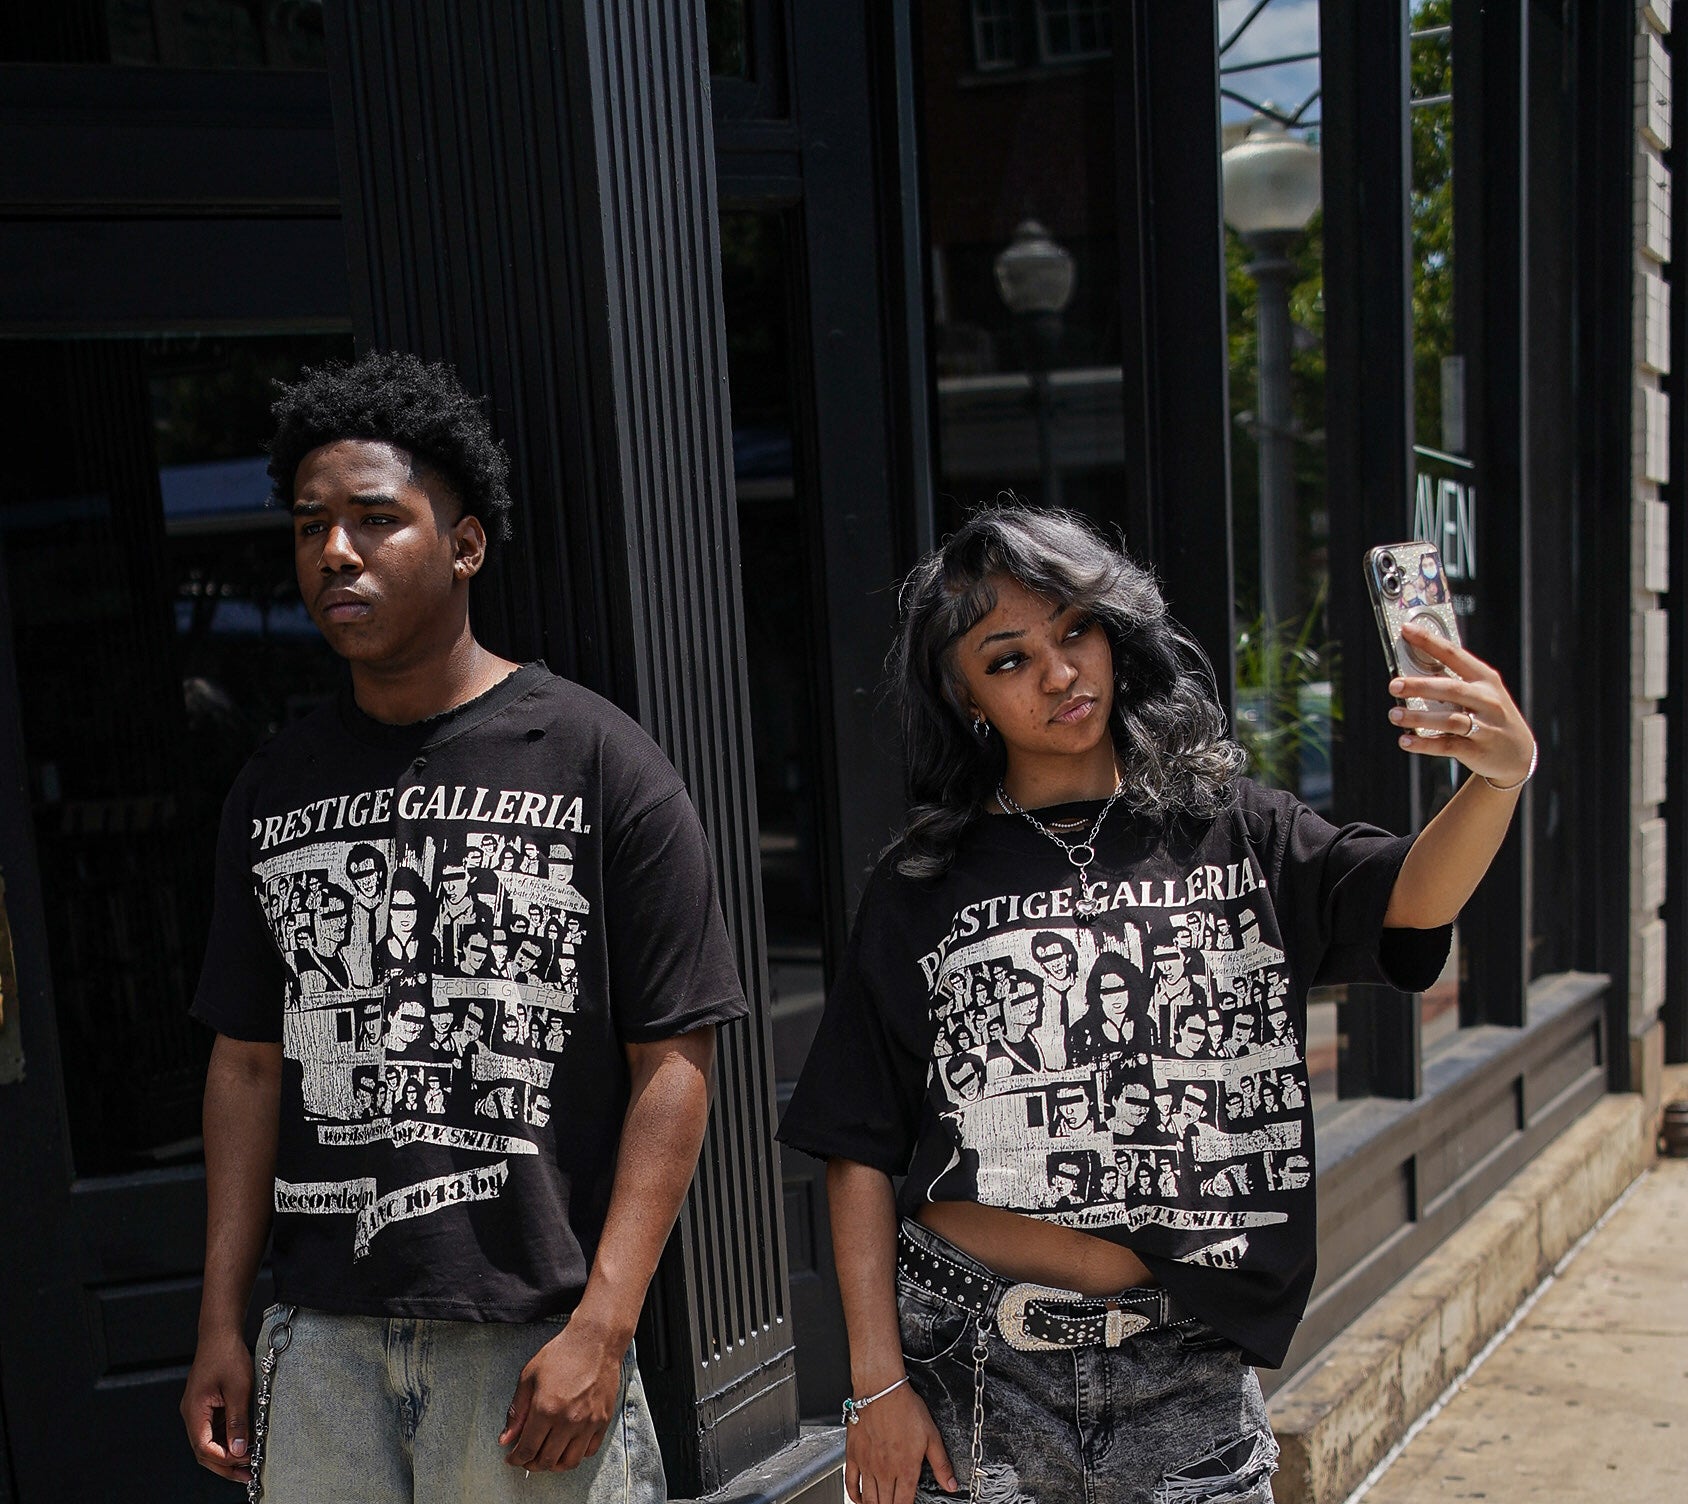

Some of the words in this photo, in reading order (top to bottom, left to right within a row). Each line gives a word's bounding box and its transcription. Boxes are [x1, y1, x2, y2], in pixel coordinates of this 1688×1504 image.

[397, 784, 592, 834] GALLERIA.
[916, 886, 1074, 994] PSTIGE
[1180, 1211, 1247, 1228] SMITH
